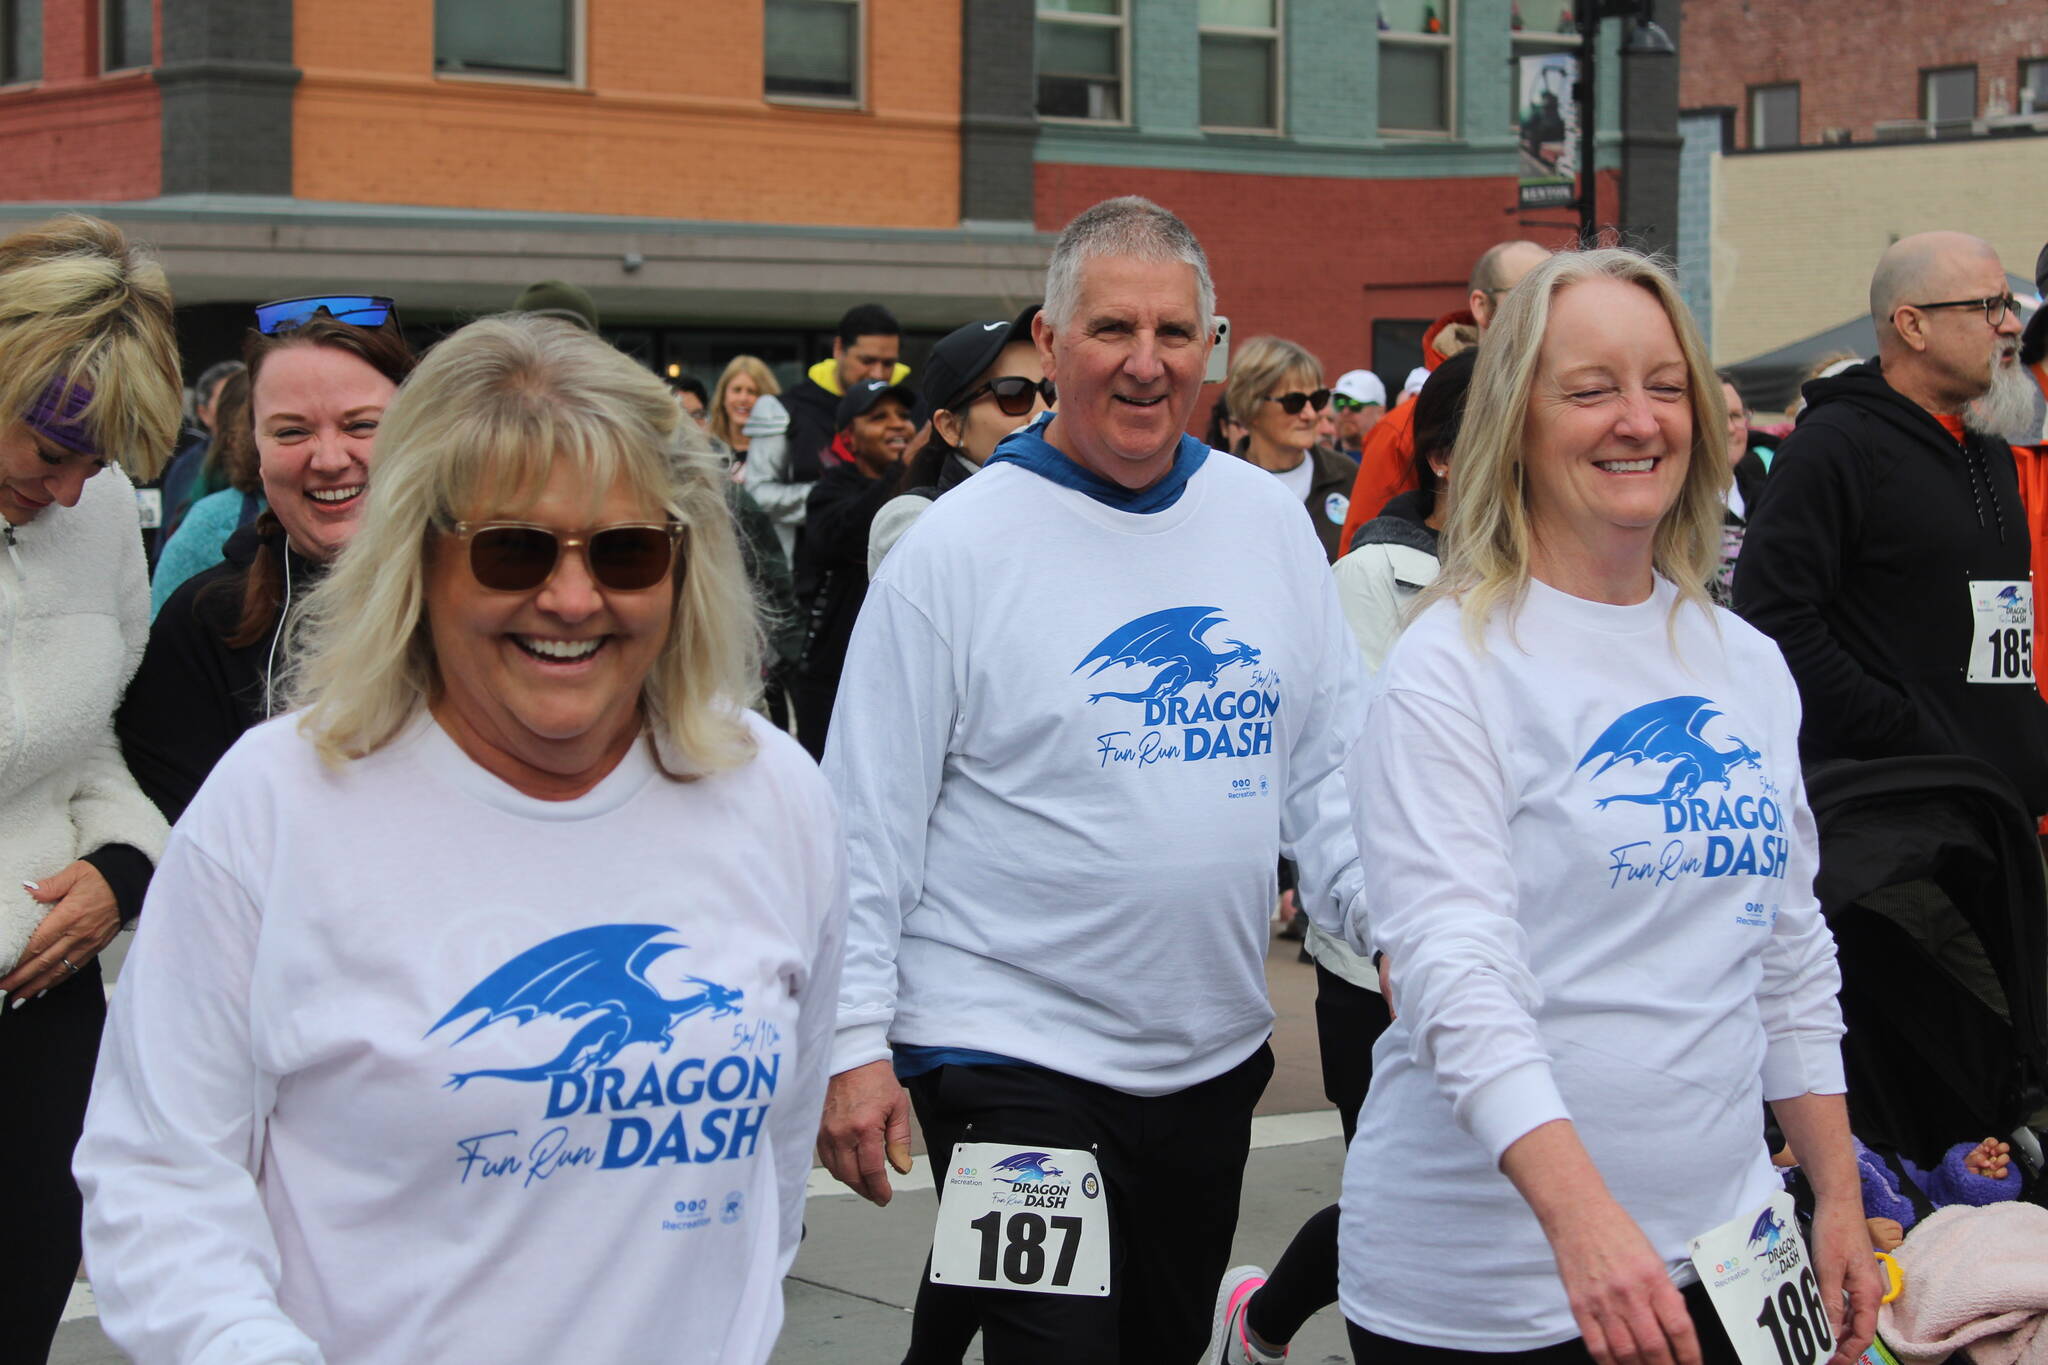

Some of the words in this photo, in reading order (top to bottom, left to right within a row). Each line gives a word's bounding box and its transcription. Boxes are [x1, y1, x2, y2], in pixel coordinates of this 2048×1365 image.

[1988, 628, 2032, 678] 185
[1143, 689, 1280, 726] DRAGON
[1097, 731, 1136, 768] Fun
[1138, 731, 1181, 769] Run
[1182, 720, 1273, 761] DASH
[1228, 790, 1257, 799] Recreation
[1609, 840, 1656, 889] Fun
[1655, 839, 1702, 887] Run
[1701, 832, 1789, 879] DASH
[542, 1053, 781, 1120] DRAGON
[456, 1130, 522, 1184] Fun
[523, 1126, 597, 1188] Run
[596, 1104, 770, 1170] DASH
[950, 1178, 982, 1186] Recreation
[1011, 1182, 1070, 1196] DRAGON
[1023, 1194, 1067, 1209] DASH
[970, 1210, 1083, 1287] 187
[1767, 1234, 1797, 1264] DRAGON
[1779, 1249, 1801, 1275] DASH
[1756, 1266, 1832, 1365] 186
